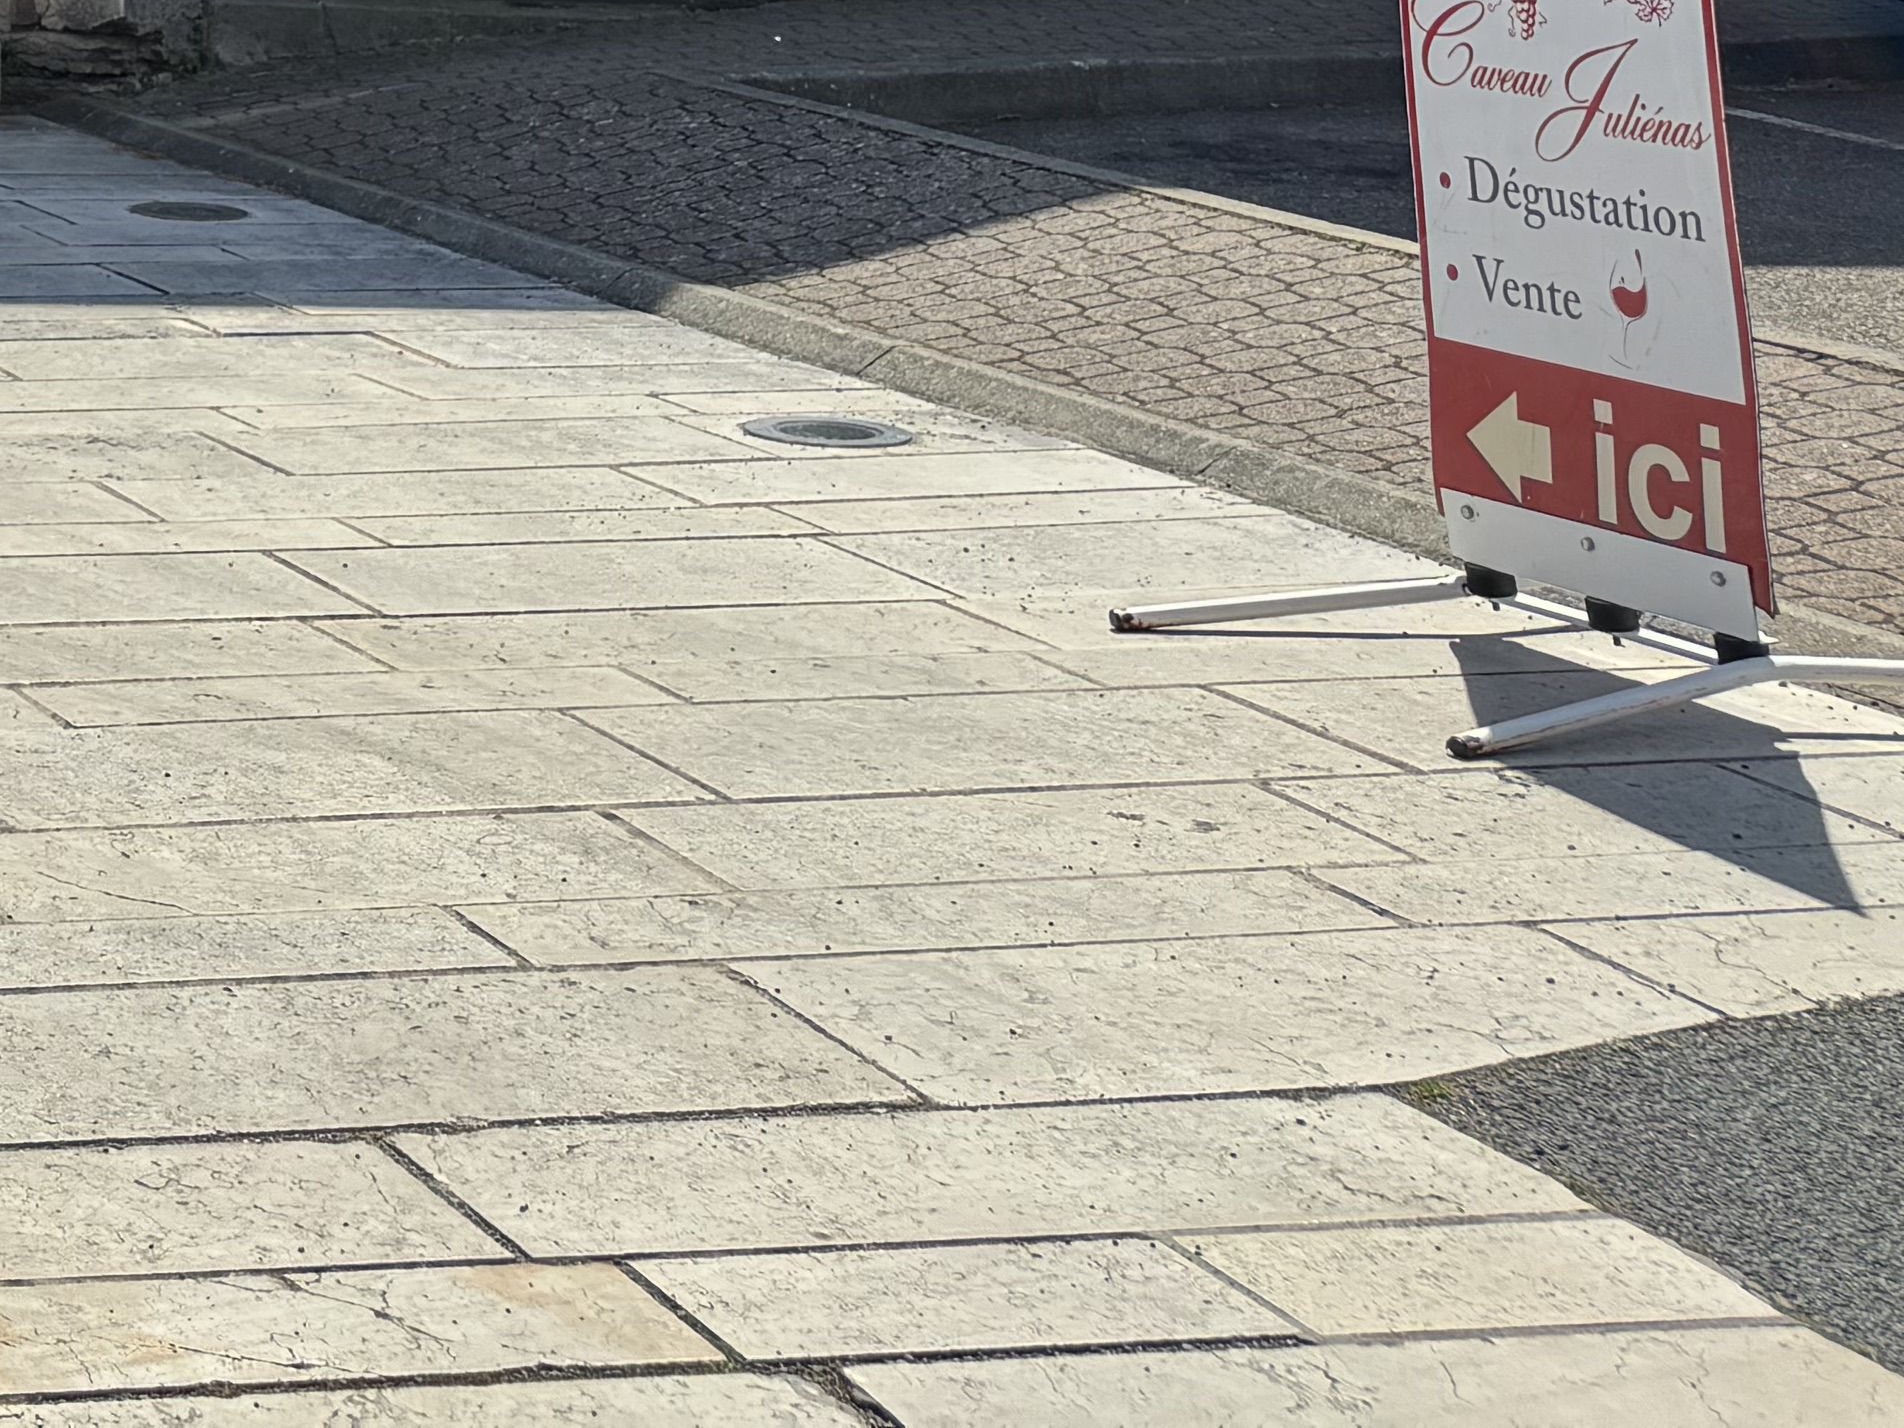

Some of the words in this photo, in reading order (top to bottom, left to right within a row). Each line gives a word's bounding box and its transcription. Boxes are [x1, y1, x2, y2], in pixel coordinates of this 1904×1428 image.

[1534, 37, 1712, 164] Juliénas
[1464, 154, 1706, 243] Dégustation
[1472, 251, 1584, 322] Vente
[1593, 396, 1727, 555] ici
